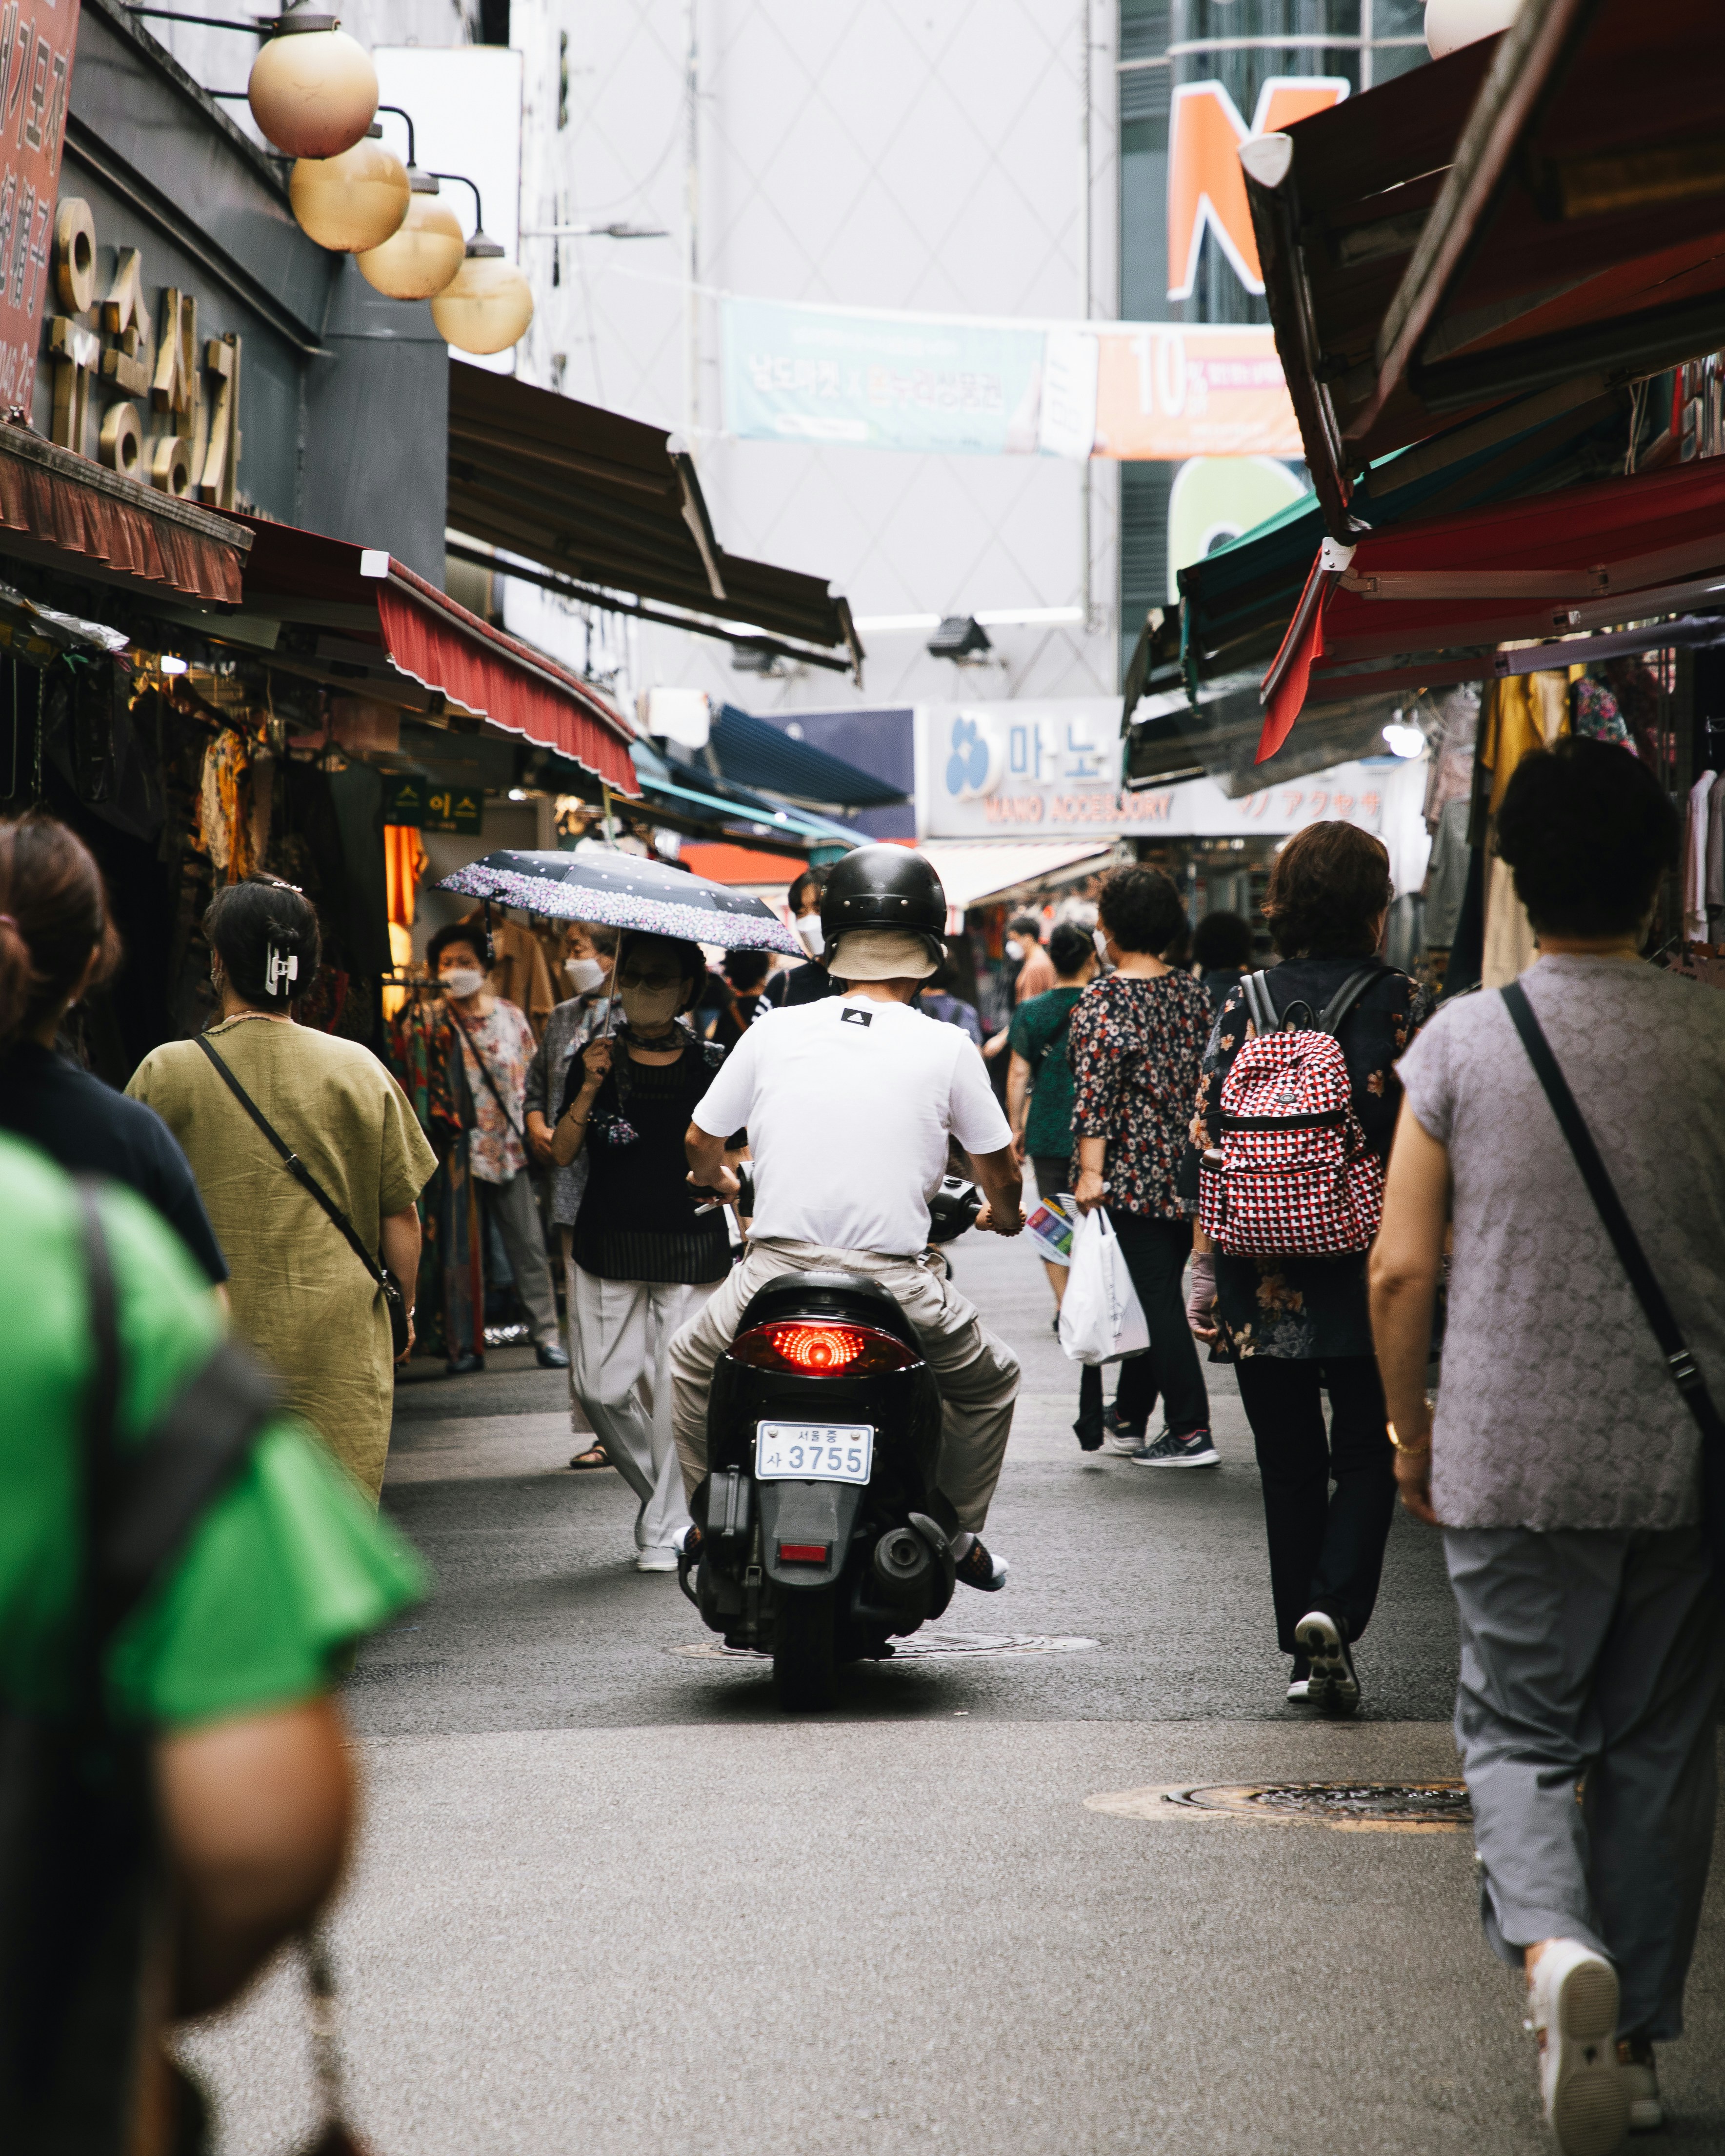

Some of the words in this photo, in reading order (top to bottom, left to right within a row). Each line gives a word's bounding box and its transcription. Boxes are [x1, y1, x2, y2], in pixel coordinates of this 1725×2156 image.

[749, 352, 840, 398] 남도마켓
[1009, 722, 1099, 779] 마노
[798, 1430, 819, 1442] 서울
[826, 1430, 837, 1443] 중
[766, 1452, 782, 1468] 사
[789, 1446, 862, 1473] 3755
